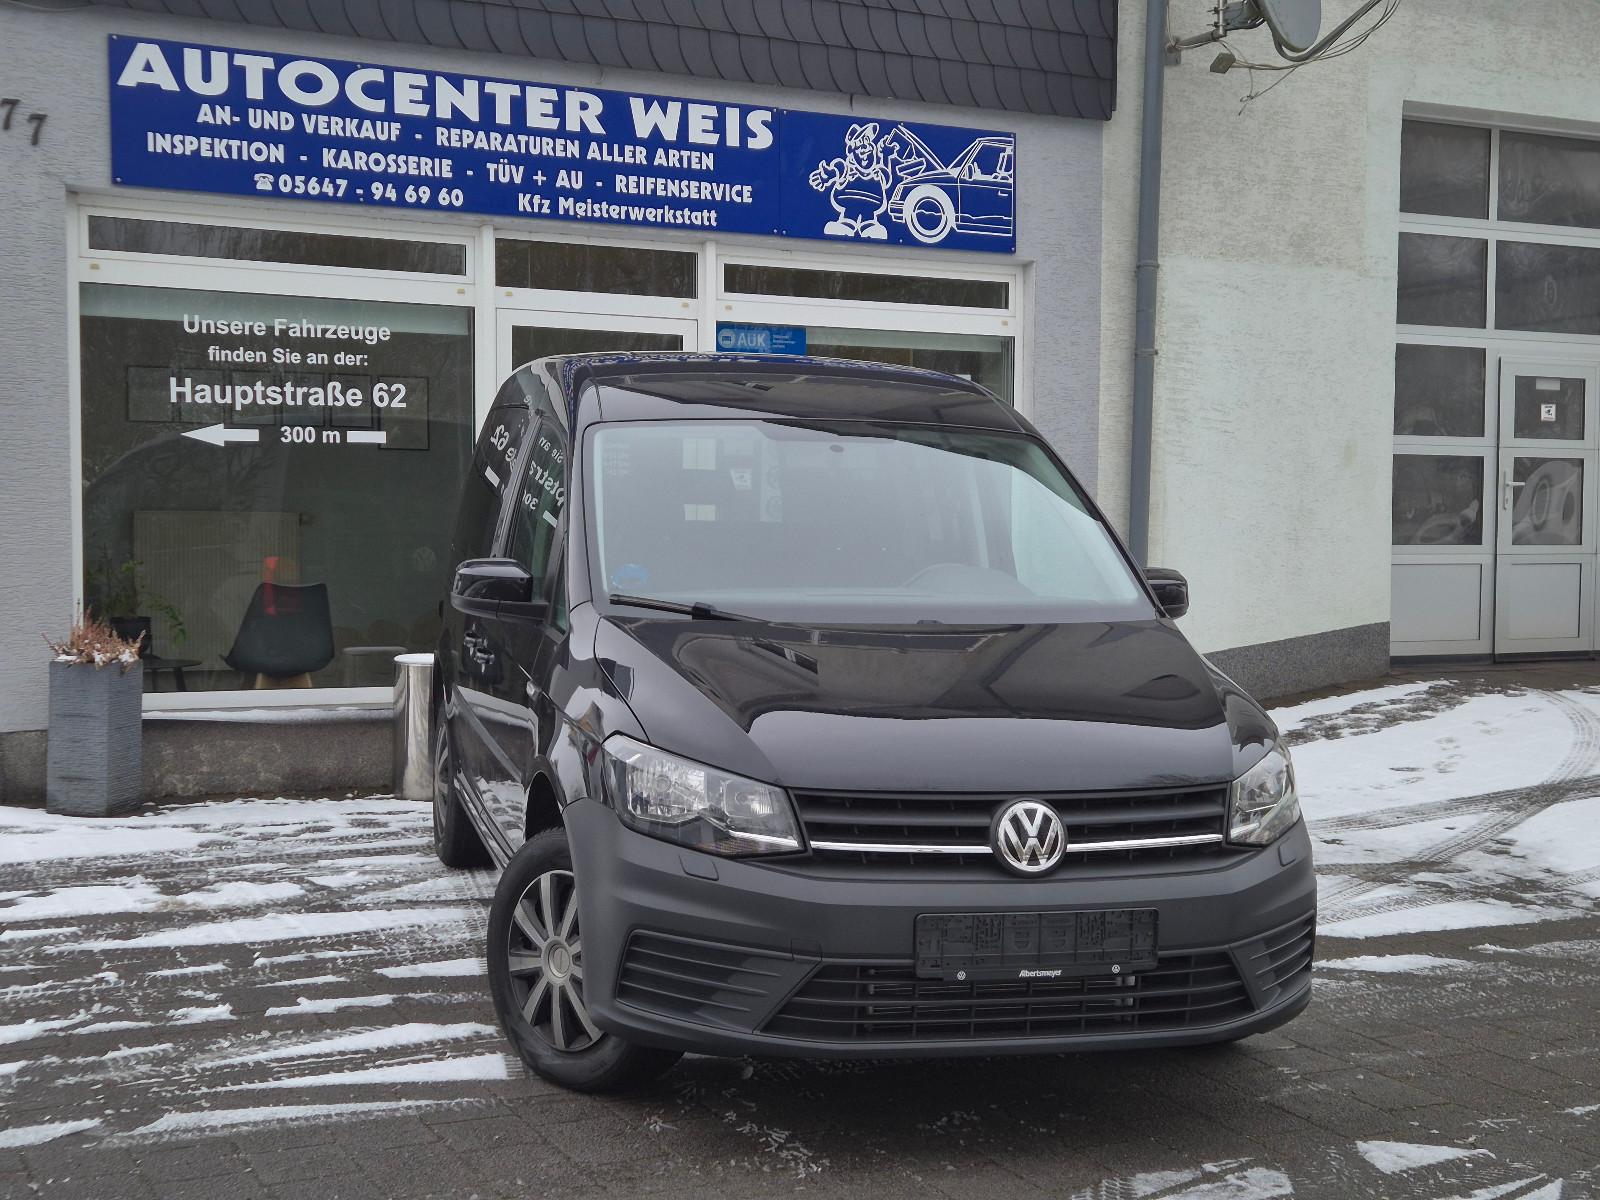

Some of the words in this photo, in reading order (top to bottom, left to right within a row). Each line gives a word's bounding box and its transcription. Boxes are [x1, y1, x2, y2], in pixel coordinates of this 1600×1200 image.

[116, 42, 606, 135] AUTOCENTER
[629, 96, 774, 150] WEIS
[197, 103, 240, 126] AN-
[248, 107, 295, 132] UND
[302, 113, 401, 142] VERKAUF
[436, 126, 580, 159] REPARATUREN
[587, 141, 648, 166] ALLER
[653, 148, 714, 172] ARTEN
[147, 131, 285, 164] INSPEKTION
[322, 147, 453, 178] KAROSSERIE
[486, 158, 525, 185] TÜV
[556, 169, 583, 190] AU
[615, 174, 753, 204] REIFENSERVICE
[278, 174, 348, 198] 05647
[371, 182, 397, 202] 94
[404, 184, 431, 204] 69
[438, 186, 464, 207] 60
[517, 192, 551, 214] Kfz
[558, 196, 718, 227] Meisterwerkstatt
[183, 314, 267, 336] Unsere
[274, 318, 391, 345] Fahrzeuge
[207, 345, 267, 363] finden
[272, 348, 301, 364] Sie
[306, 352, 328, 365] an
[334, 351, 369, 366] der:
[169, 376, 363, 411] Hauptstraße
[372, 382, 407, 408] 62
[280, 425, 316, 444] 300
[322, 428, 341, 444] m
